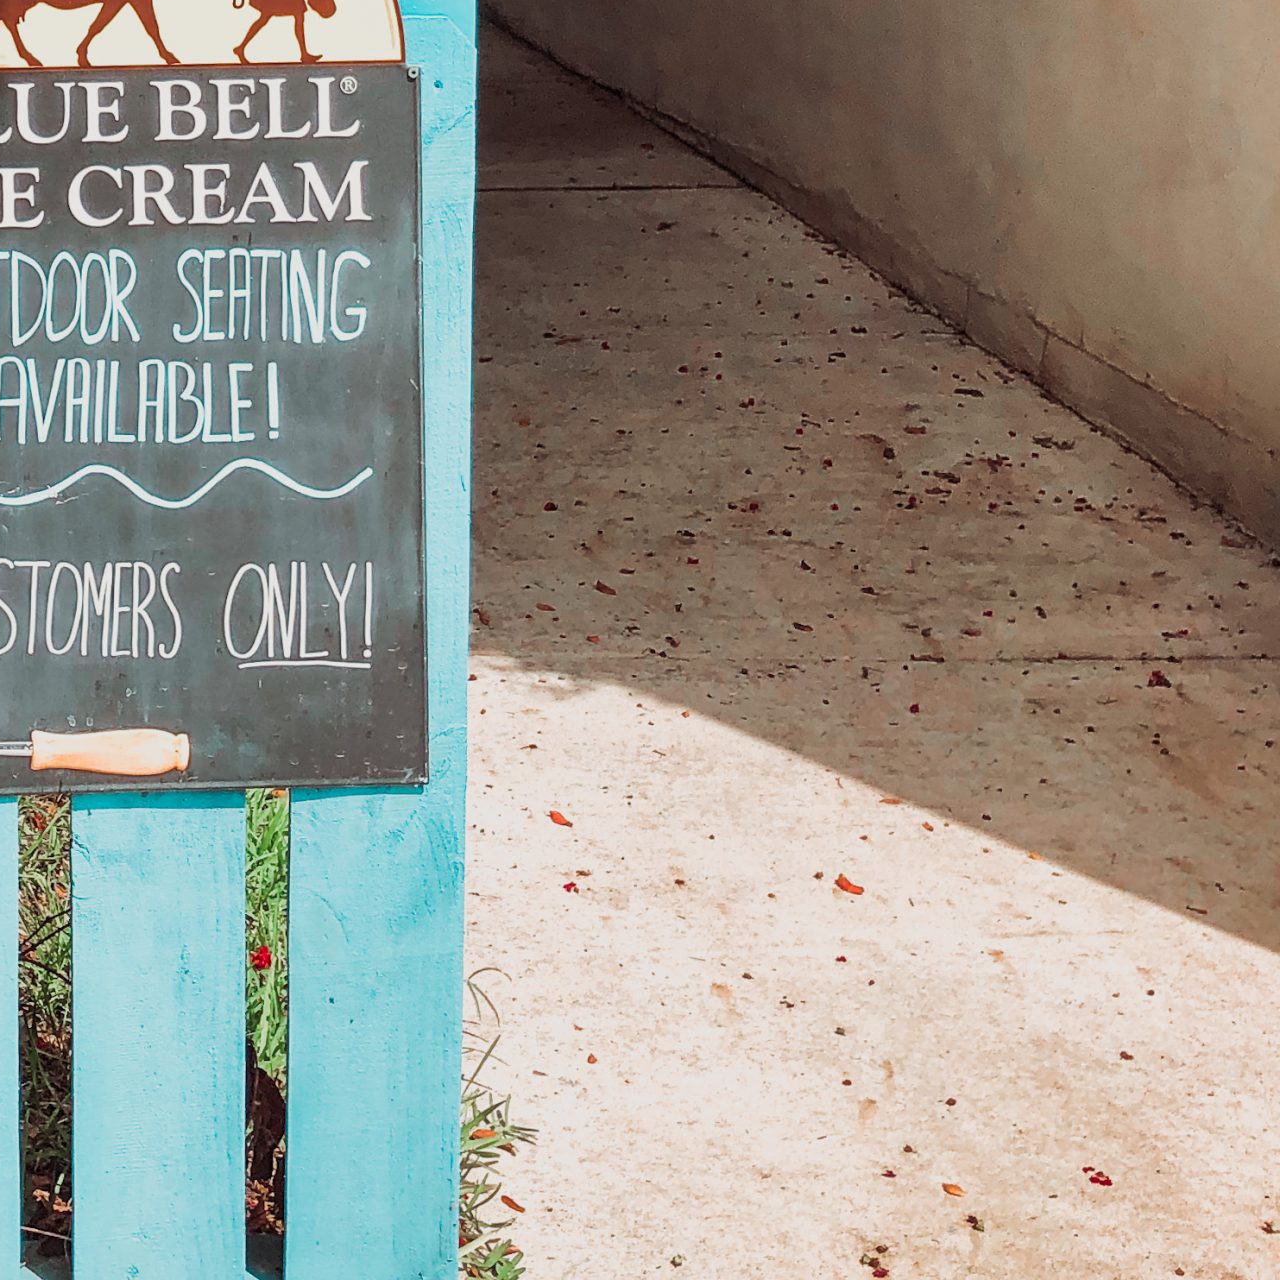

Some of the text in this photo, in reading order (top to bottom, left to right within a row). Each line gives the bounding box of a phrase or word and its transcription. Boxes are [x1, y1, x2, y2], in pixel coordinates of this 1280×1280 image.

[67, 160, 373, 228] CREAM
[172, 247, 372, 344] SEATING
[223, 561, 374, 660] ONLY!
